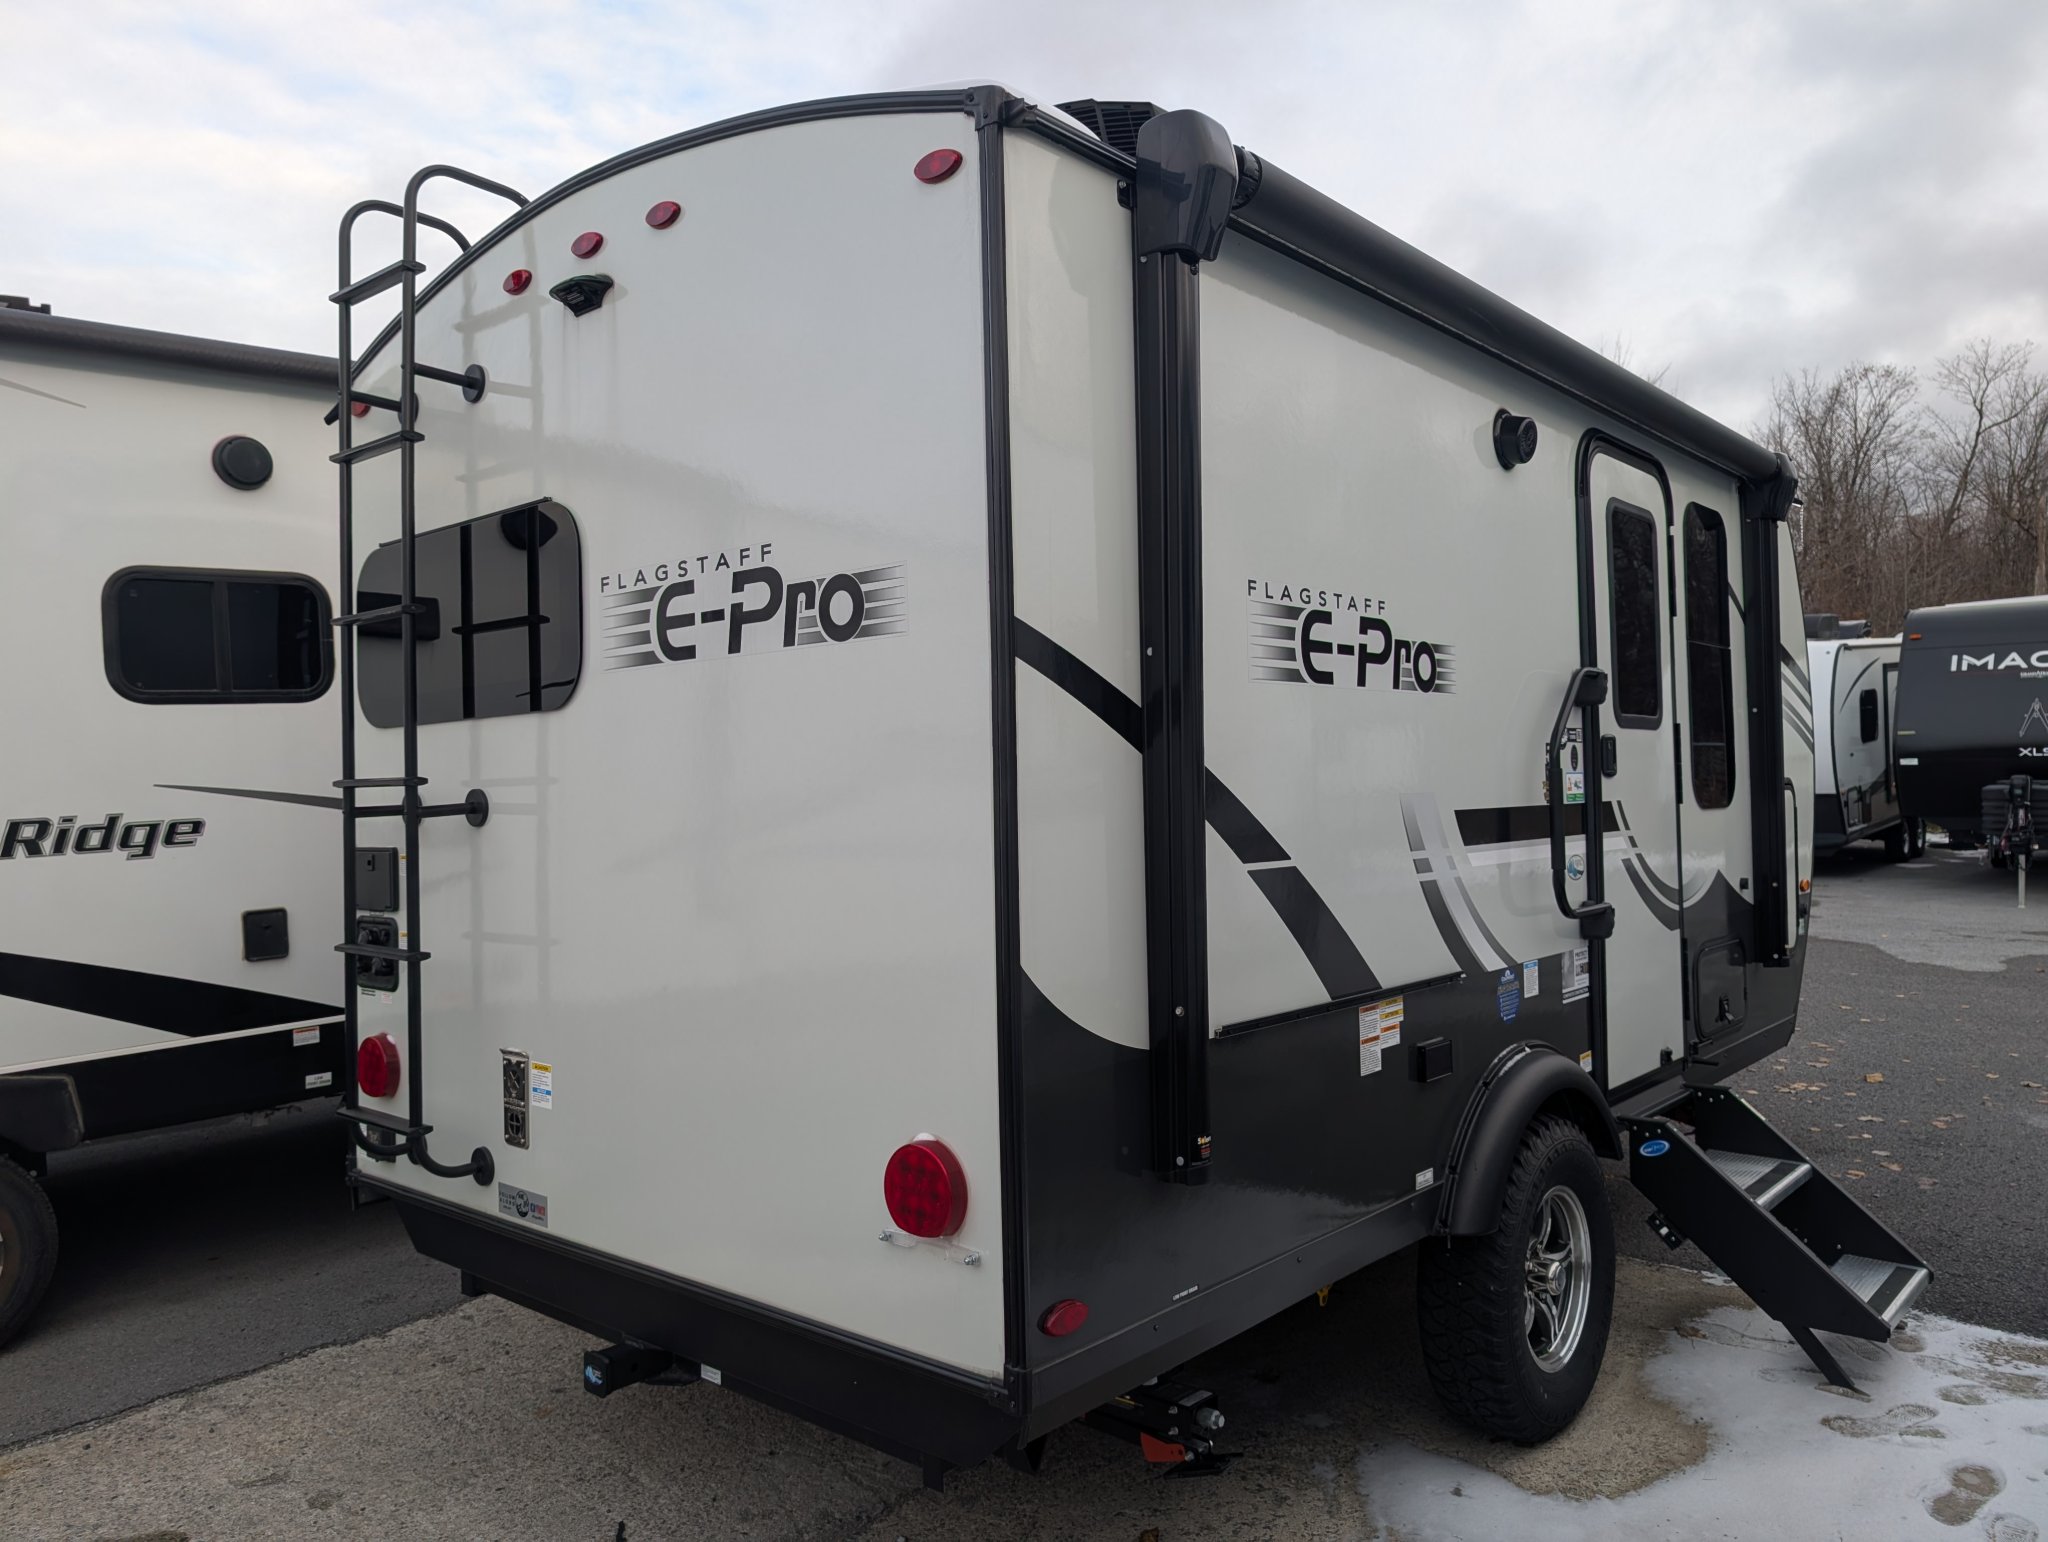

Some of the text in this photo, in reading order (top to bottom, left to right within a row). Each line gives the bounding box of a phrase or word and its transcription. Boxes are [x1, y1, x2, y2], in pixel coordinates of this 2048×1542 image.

[600, 543, 772, 593] FLAGSTAFF
[656, 565, 866, 661] E-Pro
[1247, 579, 1386, 615] FLAGSTAFF
[1301, 609, 1437, 693] E-Pro
[0, 813, 206, 861] Ridge
